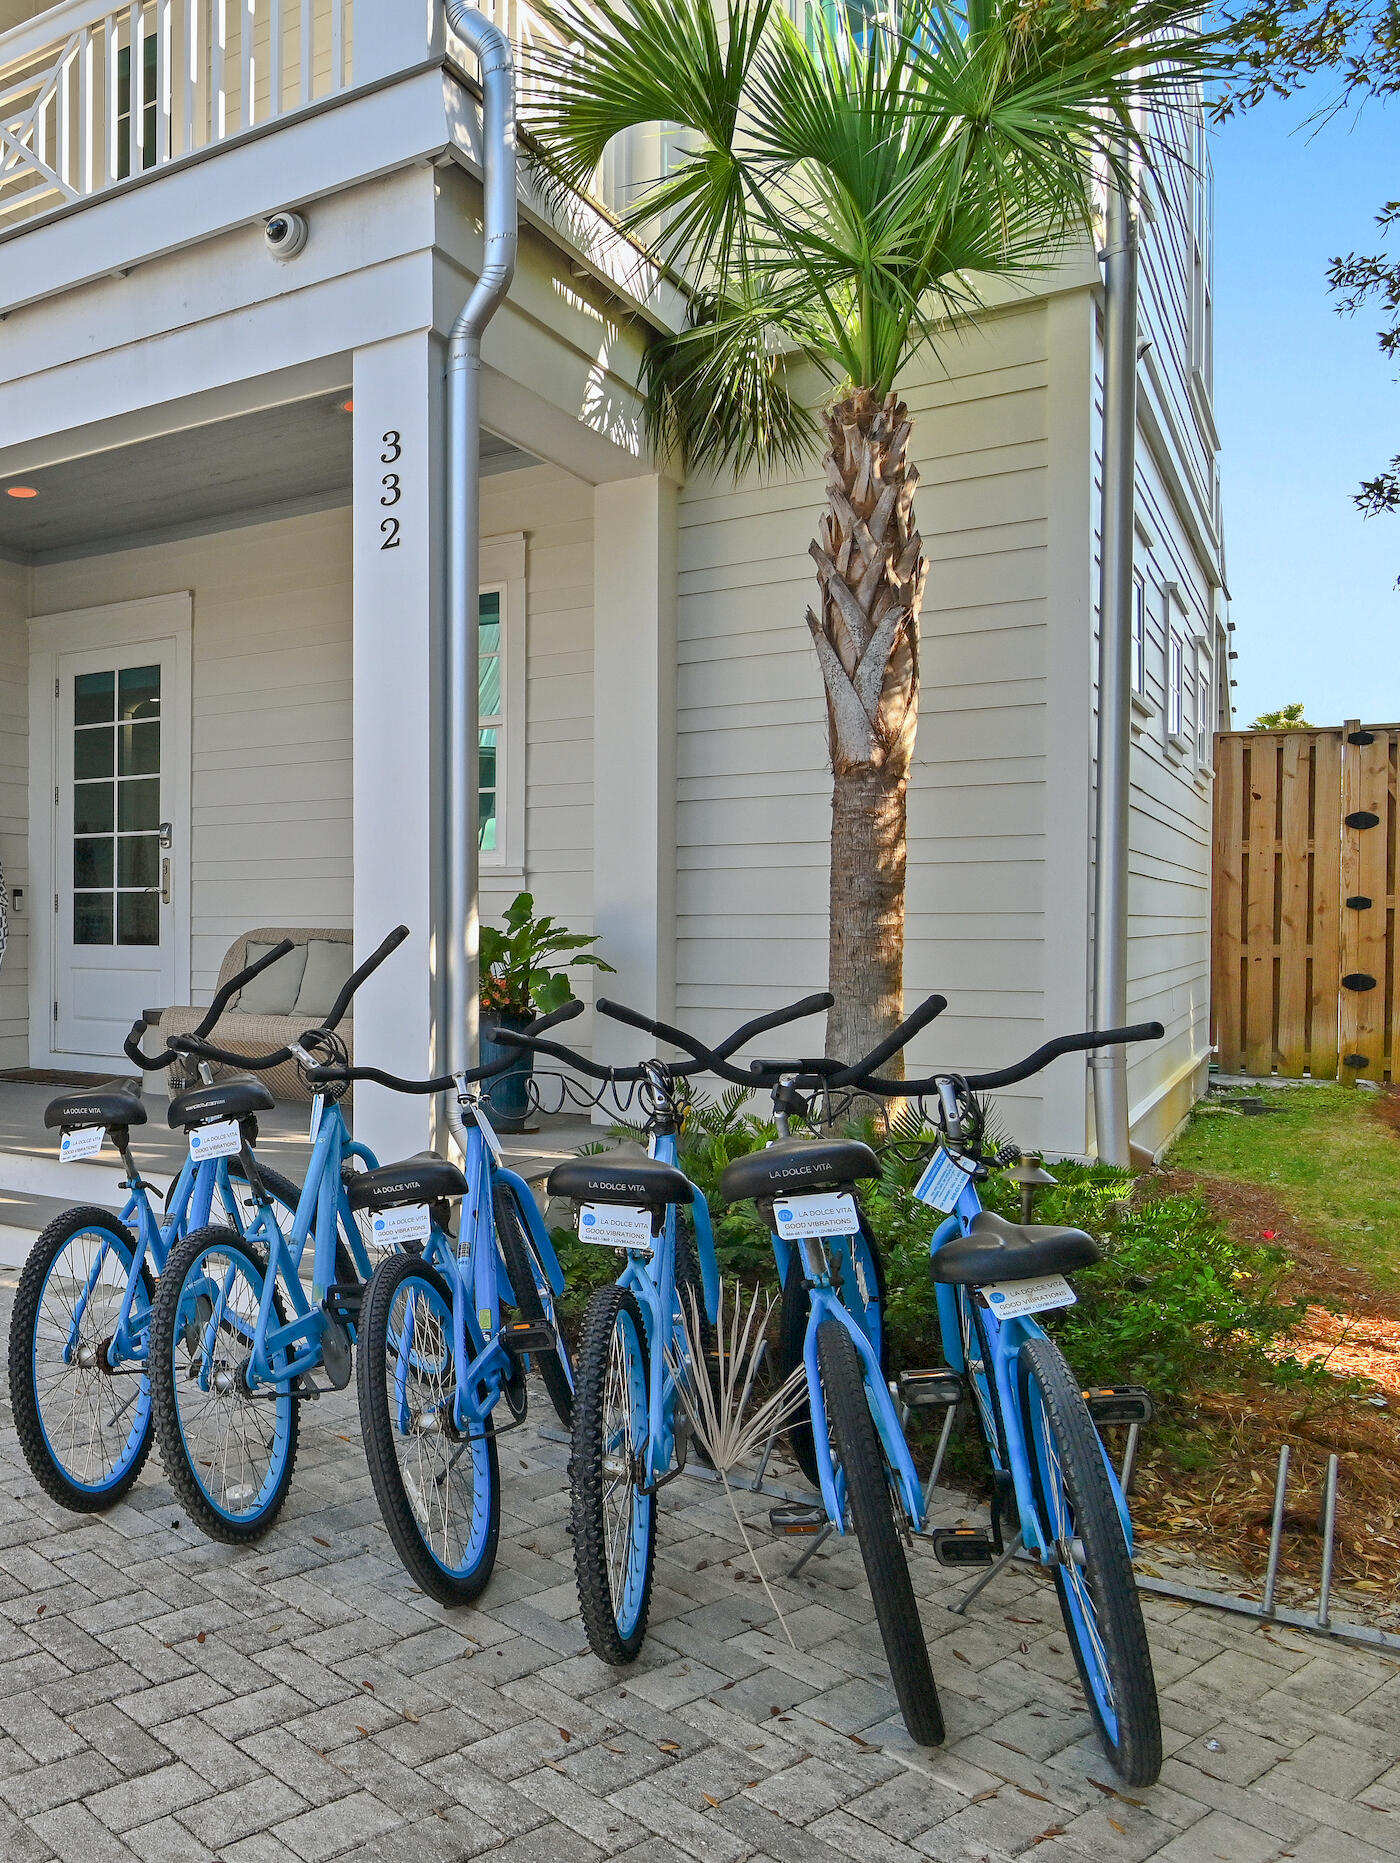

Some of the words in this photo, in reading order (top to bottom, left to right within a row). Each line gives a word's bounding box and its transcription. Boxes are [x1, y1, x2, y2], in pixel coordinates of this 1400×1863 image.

[769, 1170, 781, 1179] LA
[782, 1166, 812, 1177] DOLCE
[812, 1162, 832, 1172] VITA
[382, 1184, 404, 1193] DOLCE
[404, 1181, 421, 1190] VITA
[600, 1182, 626, 1191] DOLCE
[628, 1184, 646, 1192] VITA
[395, 1225, 426, 1234] VIBRATIONS
[784, 1222, 806, 1230] GOOD
[807, 1218, 852, 1228] VIBRATIONS
[606, 1230, 645, 1240] VIBRATIONS
[1020, 1285, 1046, 1295] DOLCE
[1046, 1281, 1064, 1289] VITA
[1000, 1301, 1021, 1310] GOOD
[1022, 1290, 1067, 1305] VIBRATIONS
